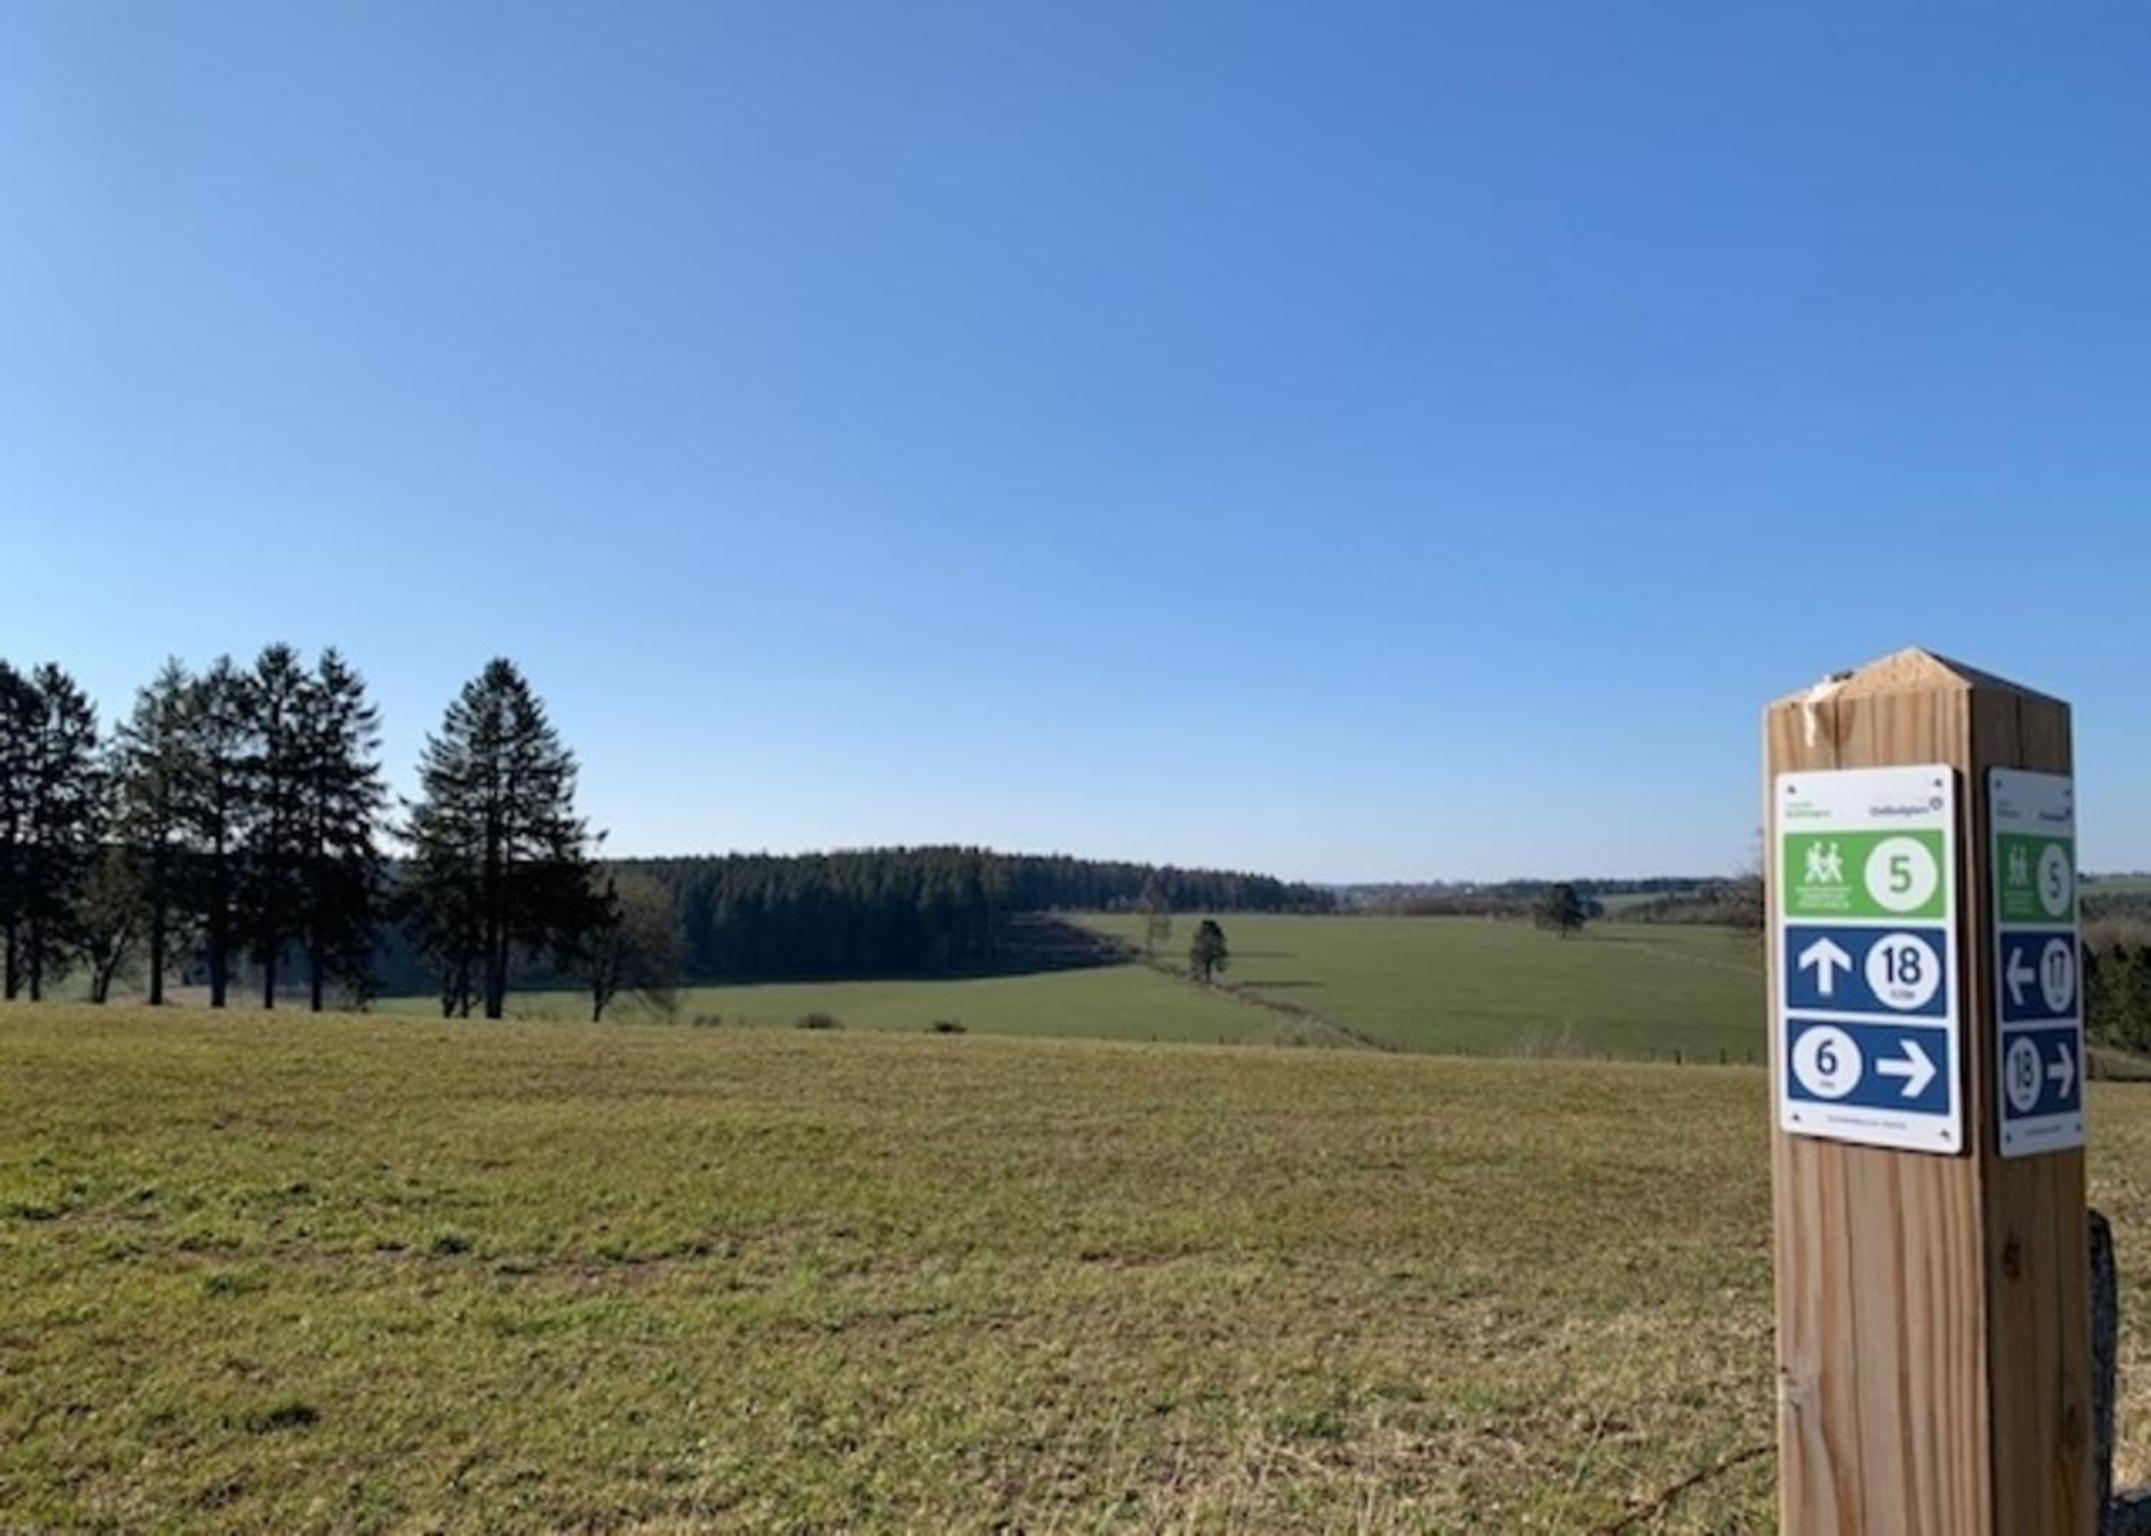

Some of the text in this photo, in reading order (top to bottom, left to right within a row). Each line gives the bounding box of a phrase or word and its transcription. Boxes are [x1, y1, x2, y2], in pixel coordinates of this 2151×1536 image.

[1889, 856, 1913, 893] 5
[2049, 861, 2062, 900] 5
[1881, 946, 1922, 985] 18
[1816, 1039, 1838, 1076] 6
